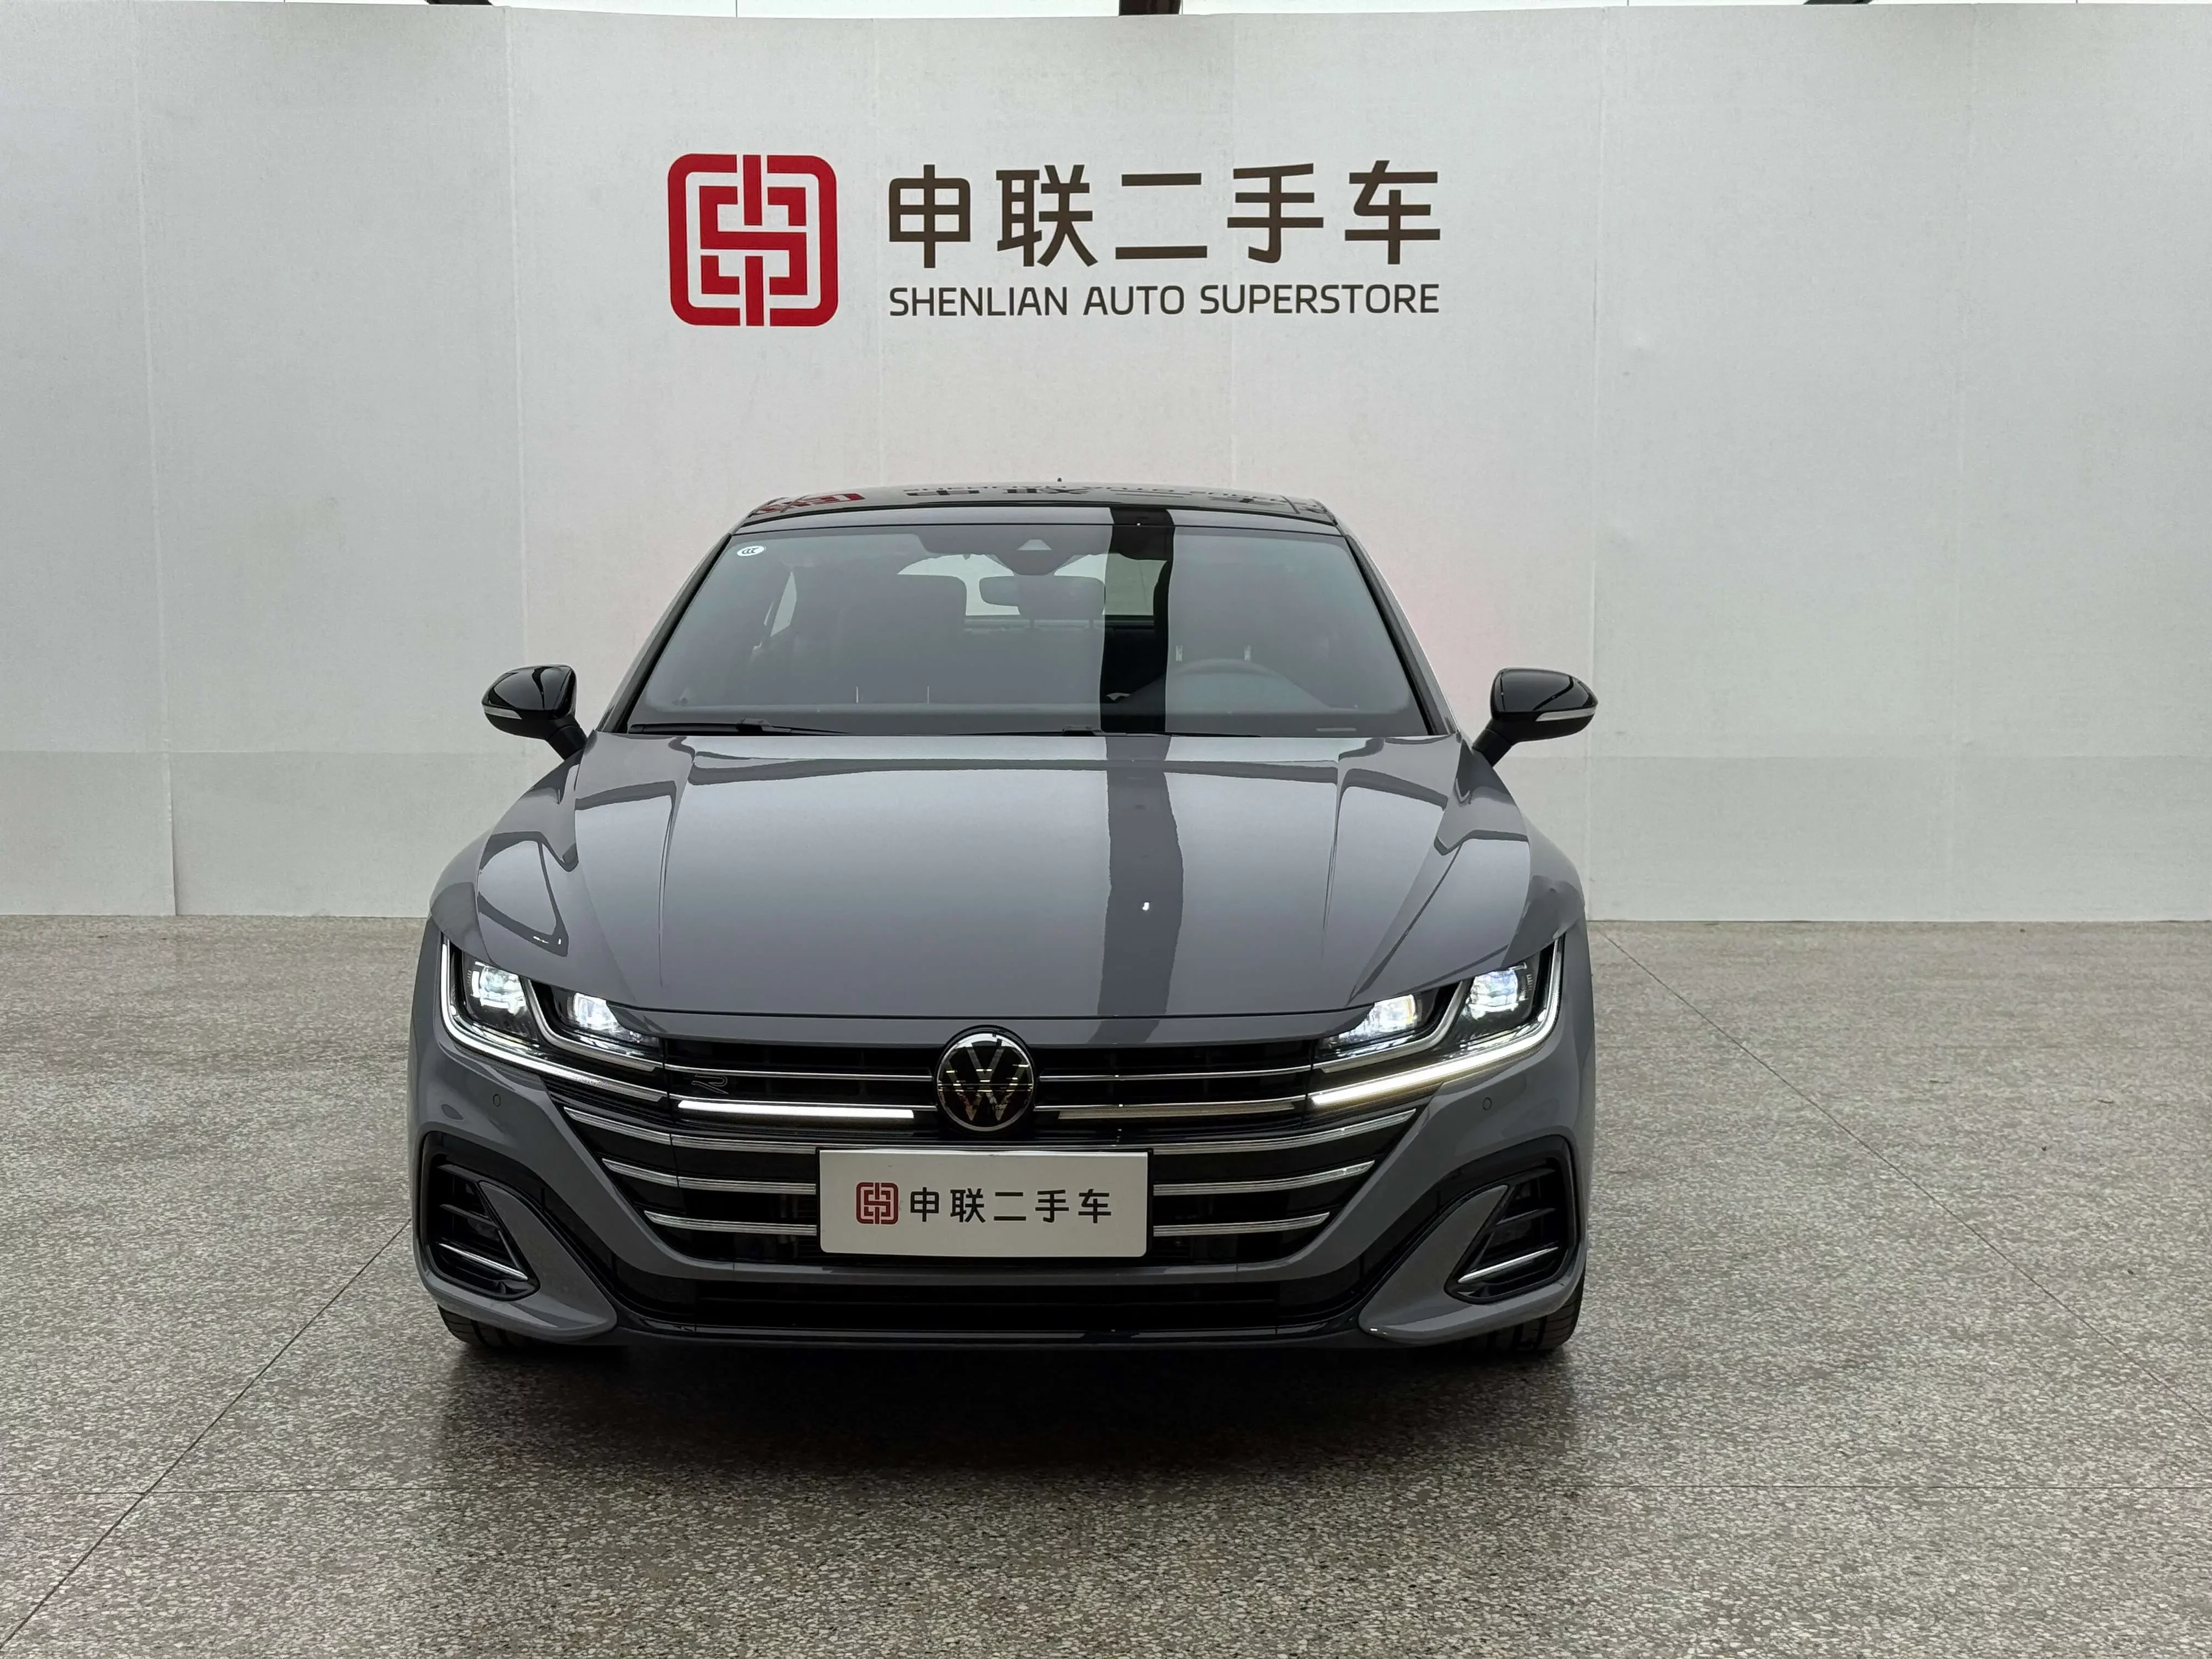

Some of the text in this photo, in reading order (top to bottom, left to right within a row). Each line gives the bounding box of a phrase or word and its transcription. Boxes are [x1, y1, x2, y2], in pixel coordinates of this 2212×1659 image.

[889, 160, 1441, 268] 申联二手车
[890, 284, 1439, 316] SHENLIAN AUTO SUPERSTORE
[910, 1186, 1112, 1224] 申联二手车
